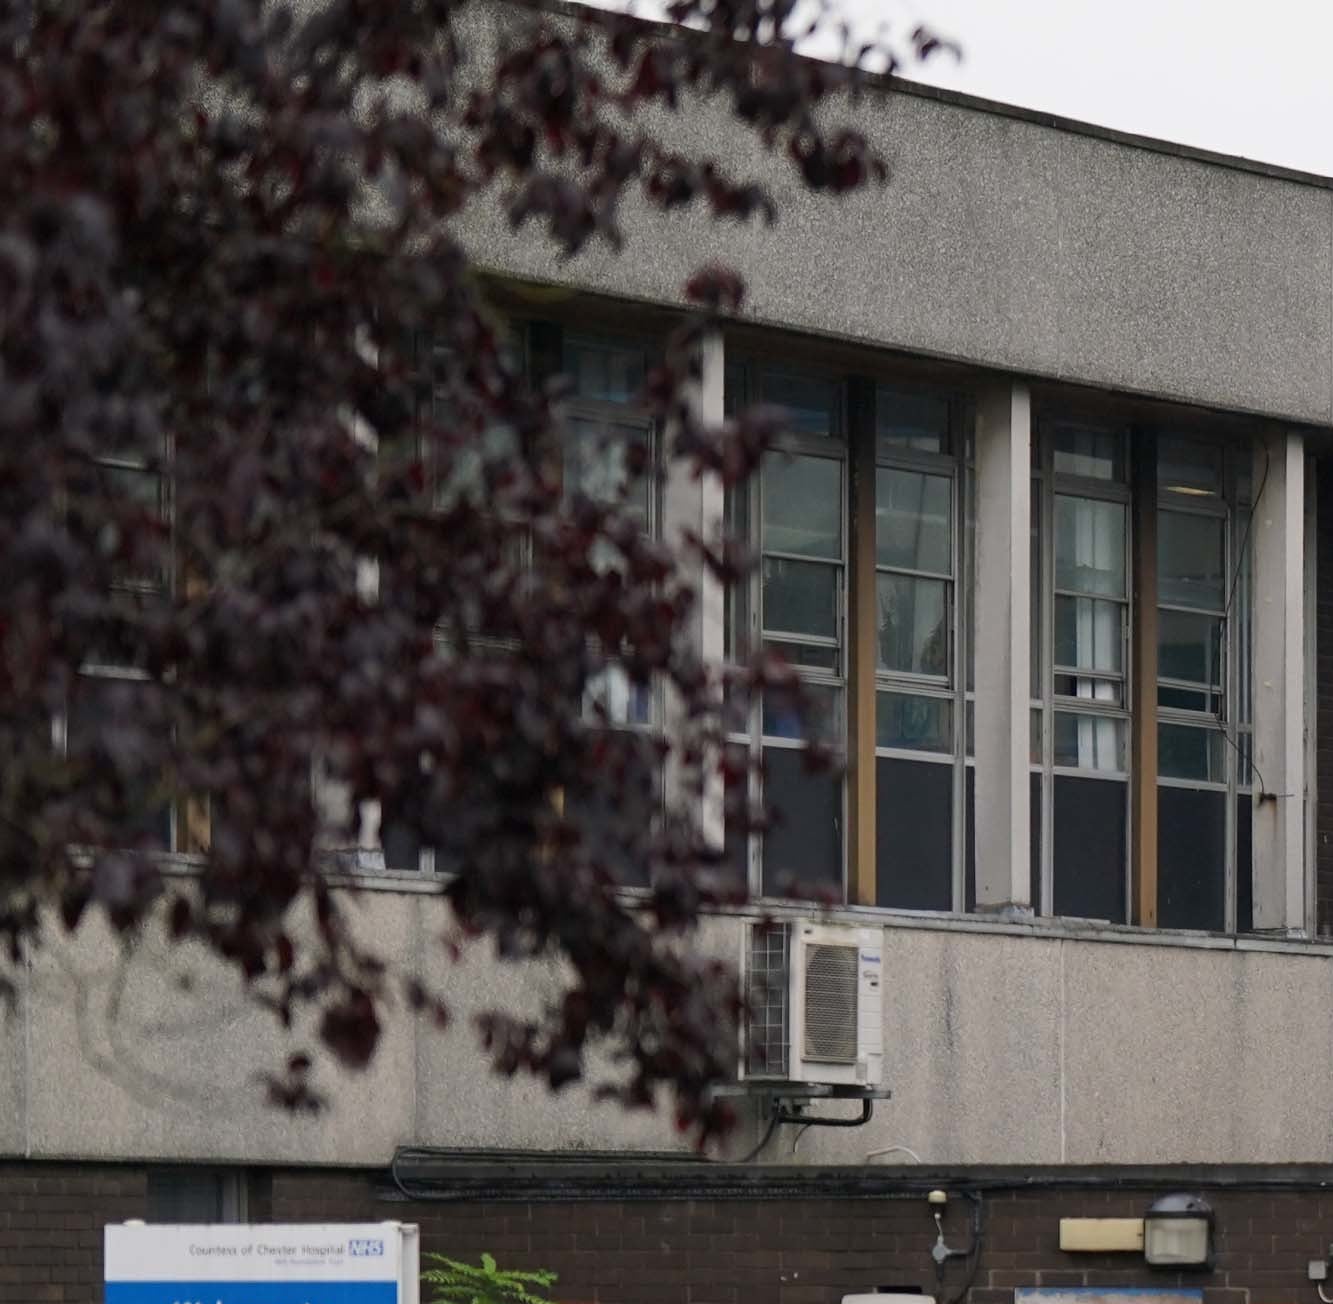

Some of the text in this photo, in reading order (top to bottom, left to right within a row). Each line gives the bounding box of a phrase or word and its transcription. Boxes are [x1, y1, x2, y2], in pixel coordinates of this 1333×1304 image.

[189, 1240, 384, 1258] Countess of Chester Hospital NHS
